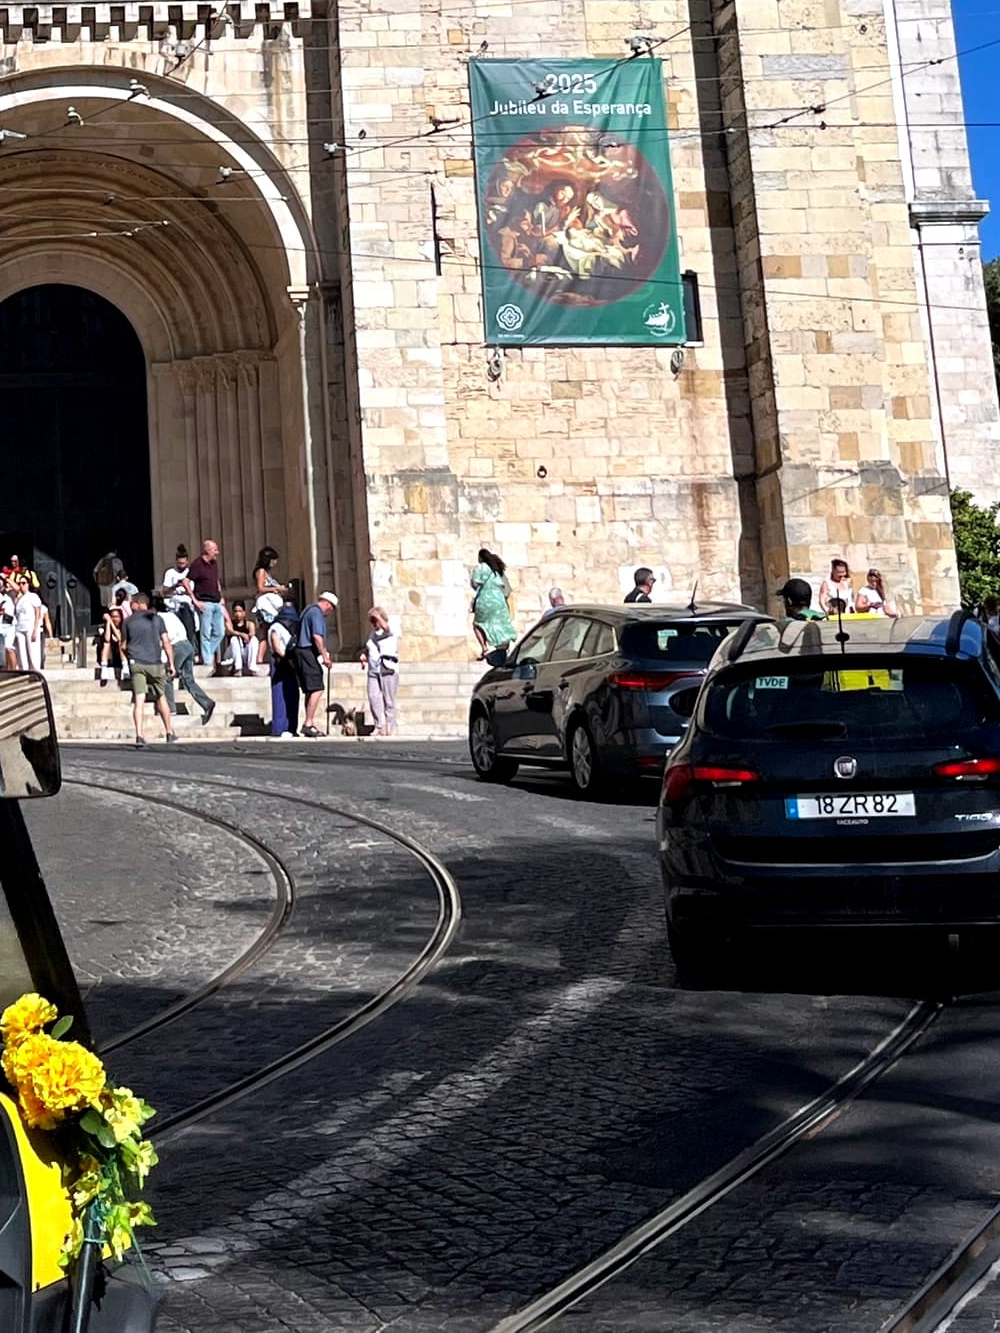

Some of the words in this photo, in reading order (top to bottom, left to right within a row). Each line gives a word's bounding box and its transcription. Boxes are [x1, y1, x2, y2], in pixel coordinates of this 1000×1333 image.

[545, 73, 597, 94] 2025
[489, 100, 546, 115] Jubileu
[551, 100, 569, 115] da
[573, 100, 652, 117] Esperança
[758, 677, 786, 687] TVDE
[815, 795, 834, 814] 18
[839, 794, 870, 814] ZR
[872, 794, 898, 813] 82
